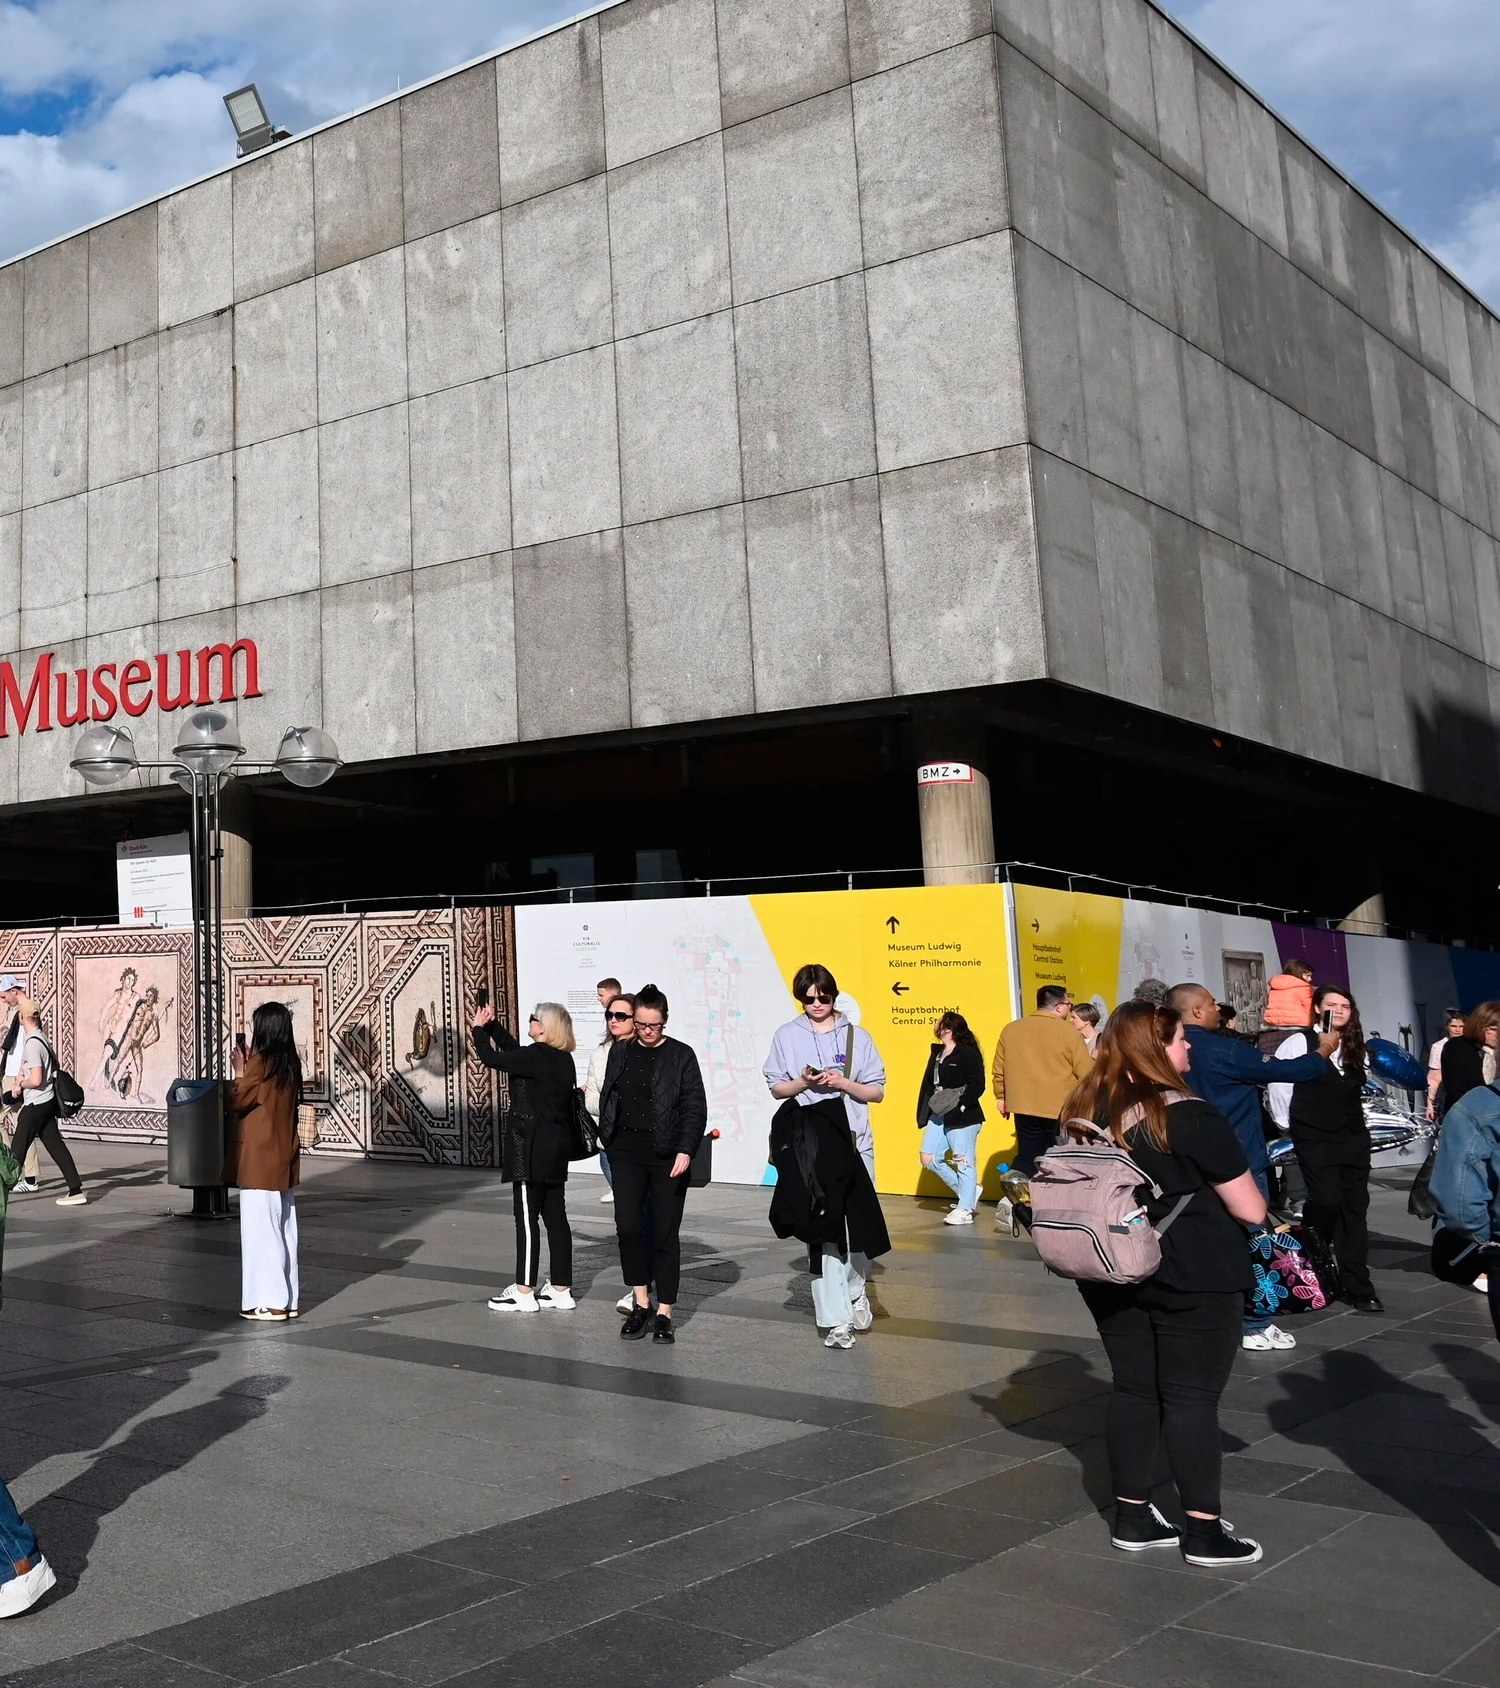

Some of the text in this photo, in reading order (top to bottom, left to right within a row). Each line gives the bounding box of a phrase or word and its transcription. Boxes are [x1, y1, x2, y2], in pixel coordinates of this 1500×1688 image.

[922, 767, 950, 779] BMZ
[888, 942, 962, 952] Museum Ludwig
[1032, 943, 1061, 953] Hauptbahnhof
[888, 958, 982, 968] Kölner Philharmonie
[1033, 953, 1064, 964] Central Station
[1034, 971, 1067, 983] Museum Ludwig
[891, 1006, 960, 1015] Hauptbahnhof
[892, 1017, 926, 1025] Central
